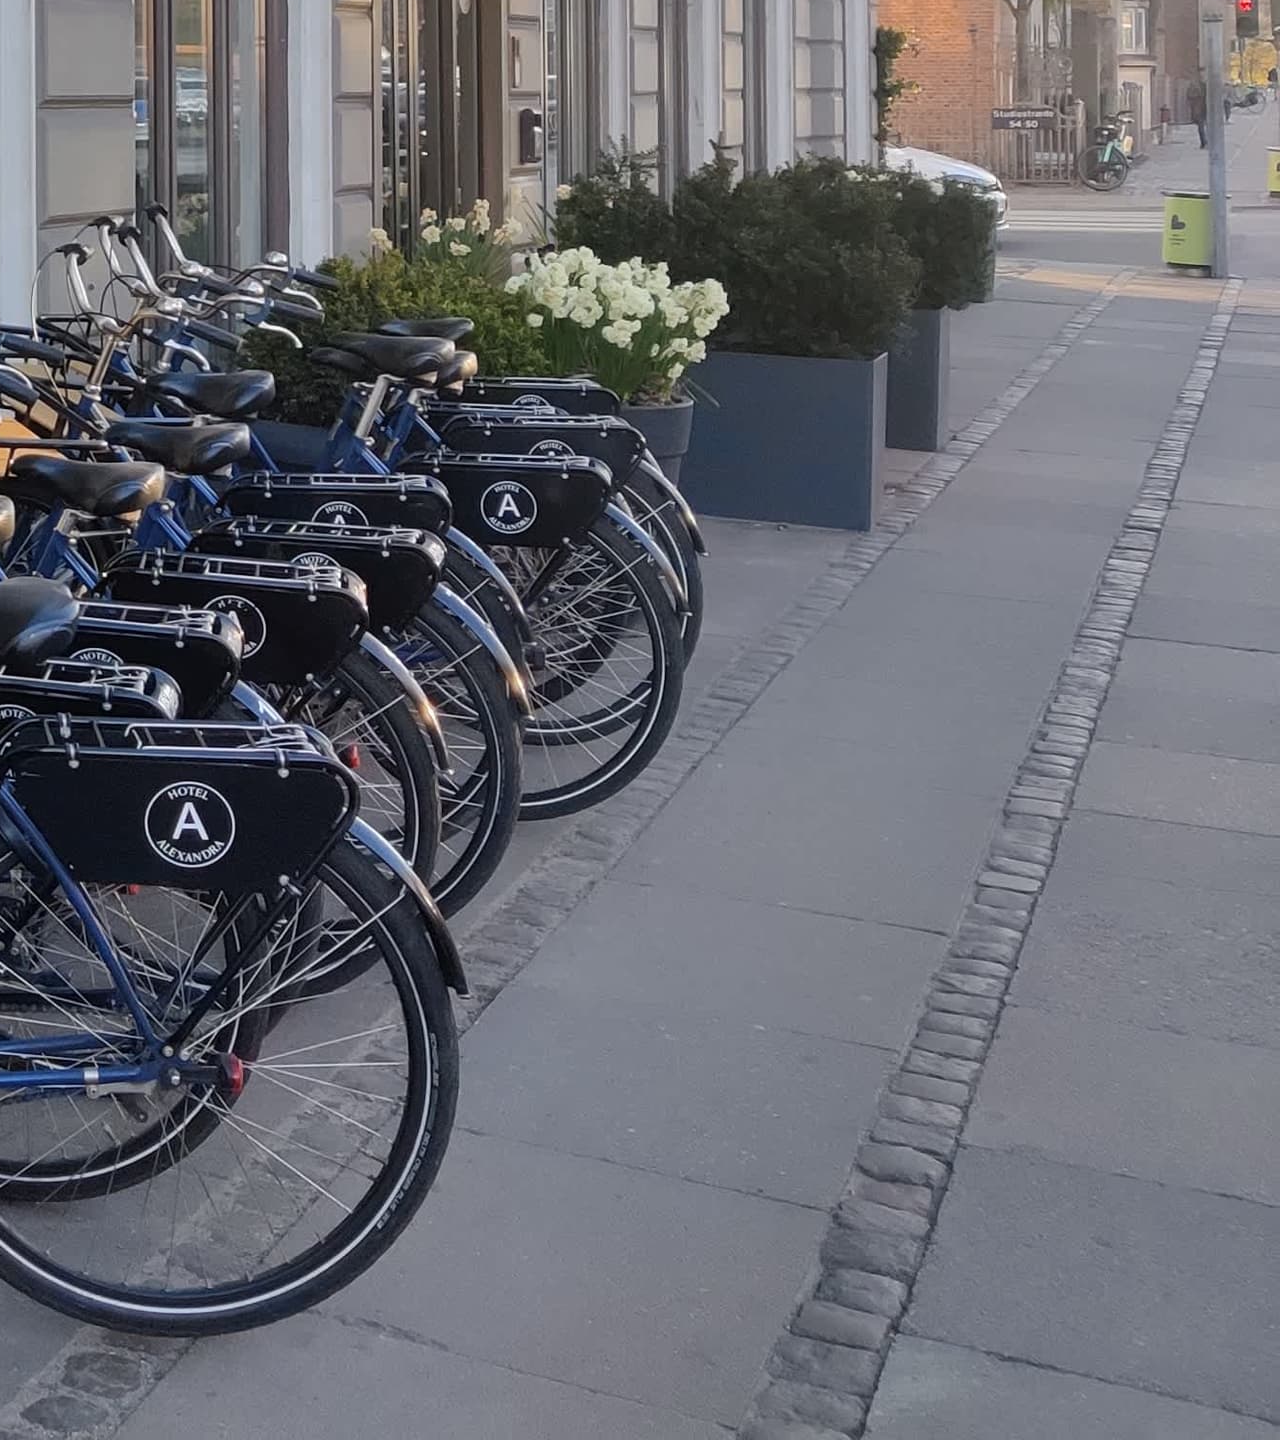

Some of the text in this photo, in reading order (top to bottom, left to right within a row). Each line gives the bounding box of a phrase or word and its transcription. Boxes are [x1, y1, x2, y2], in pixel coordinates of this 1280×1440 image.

[498, 493, 521, 518] A
[167, 785, 209, 801] HOTEL
[172, 801, 210, 841] A
[156, 840, 225, 863] ALEXANDRA
